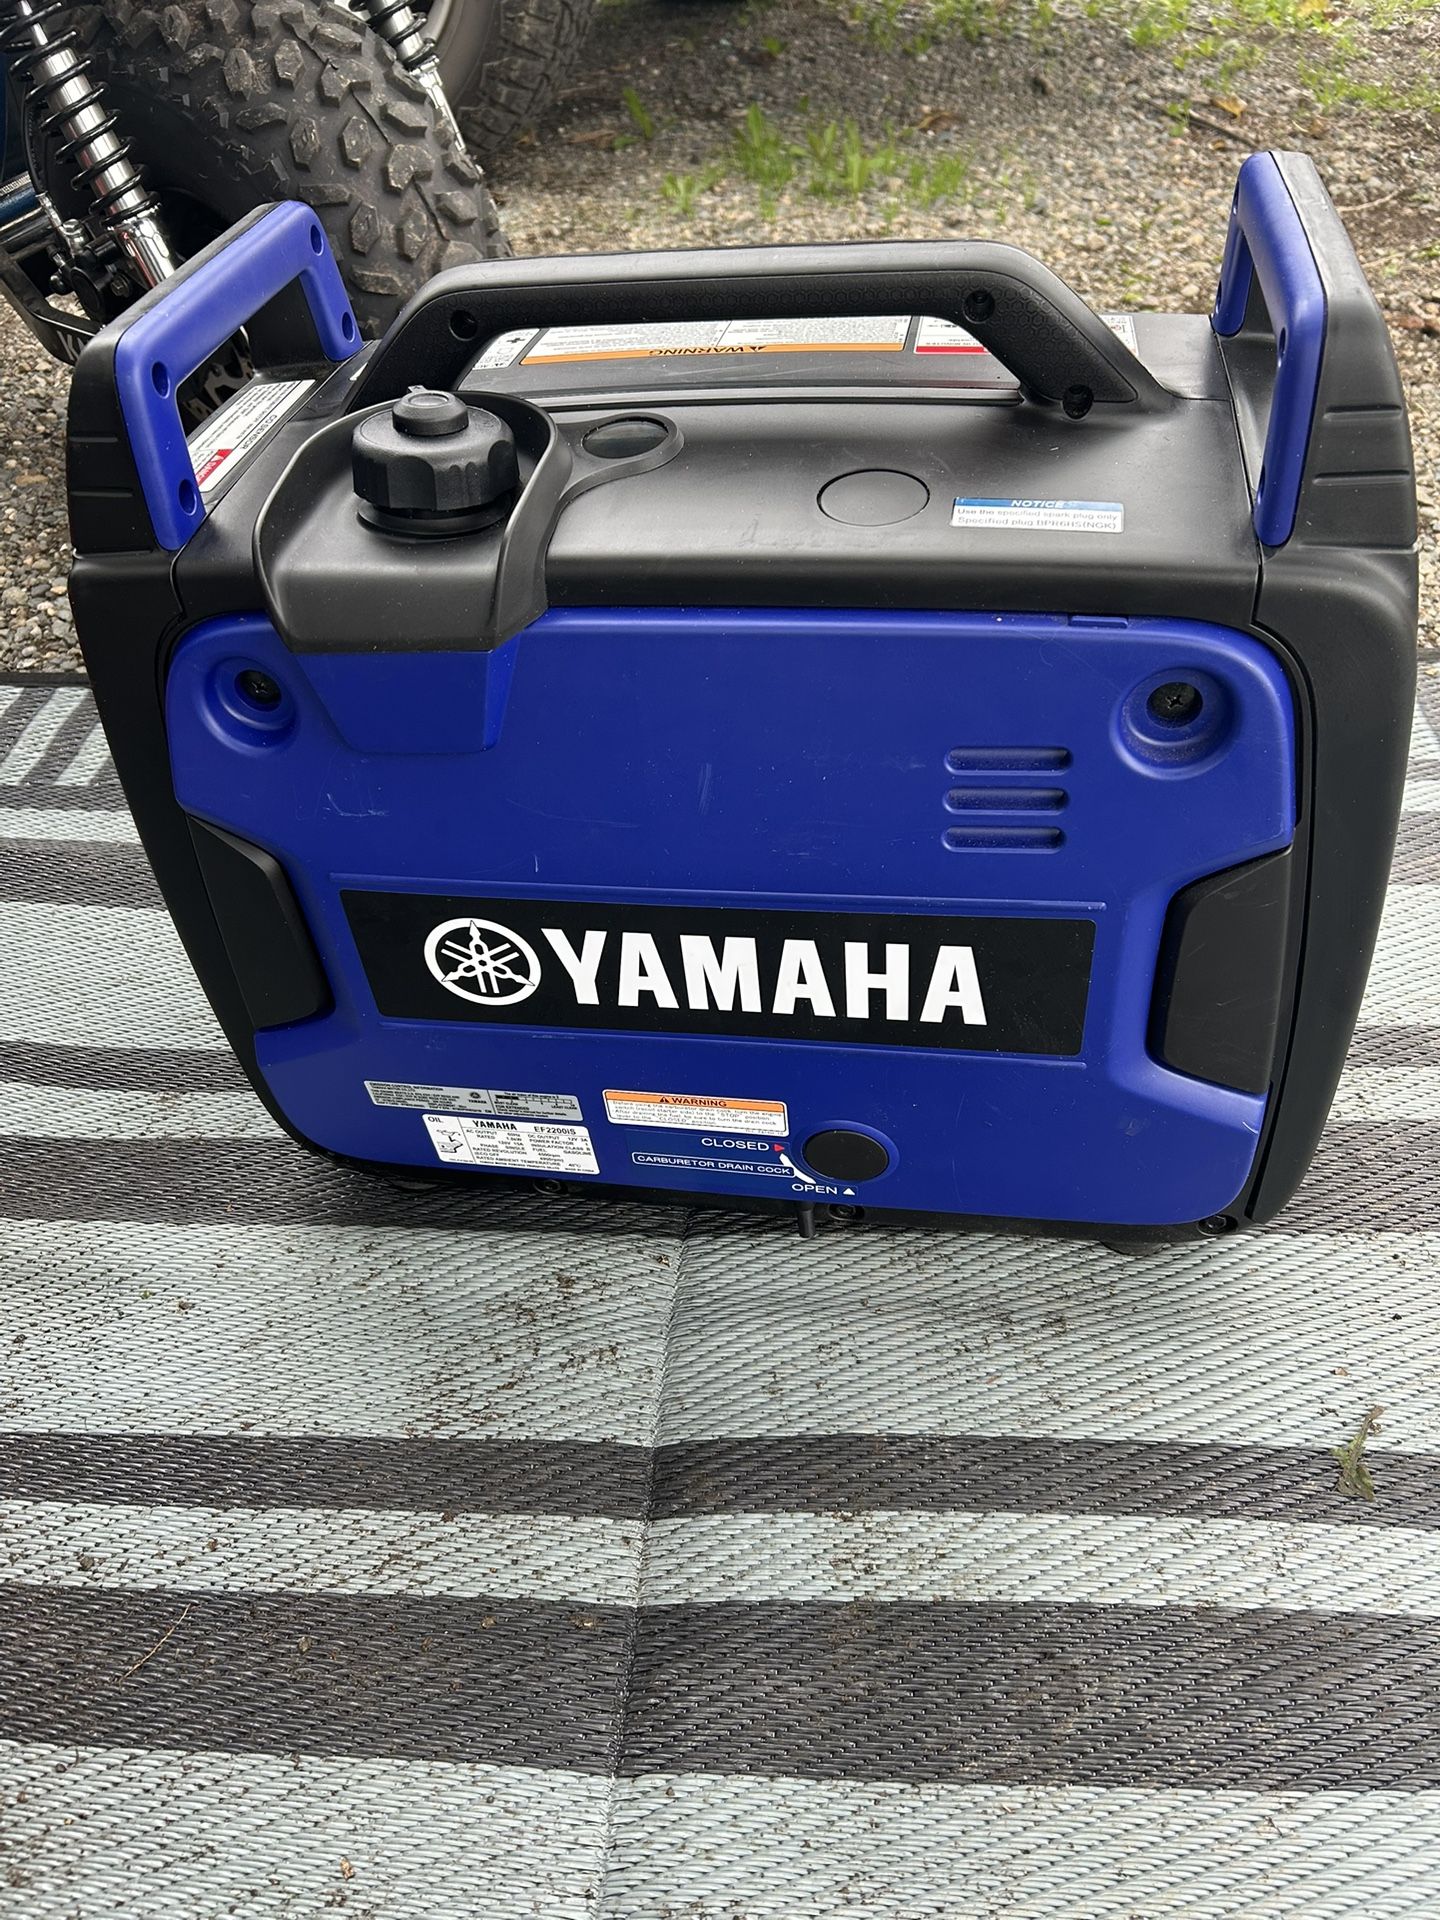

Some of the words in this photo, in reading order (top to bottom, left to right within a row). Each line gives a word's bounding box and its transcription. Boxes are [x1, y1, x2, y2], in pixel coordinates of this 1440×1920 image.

[649, 346, 743, 356] WARNING
[1010, 500, 1064, 508] NOTICE
[958, 517, 1009, 526] Specified
[1011, 518, 1034, 526] plug
[1043, 512, 1070, 520] spark
[1073, 512, 1094, 521] plug
[540, 927, 988, 1026] YAMAHA
[671, 1097, 727, 1106] WARNING
[472, 1120, 517, 1130] YAMAHA
[534, 1126, 576, 1135] EF2200iS
[701, 1138, 770, 1151] CLOSED
[637, 1155, 715, 1168] CARBURETOR
[718, 1162, 754, 1172] DRAIN
[757, 1166, 791, 1175] COCK
[791, 1183, 838, 1195] OPEN
